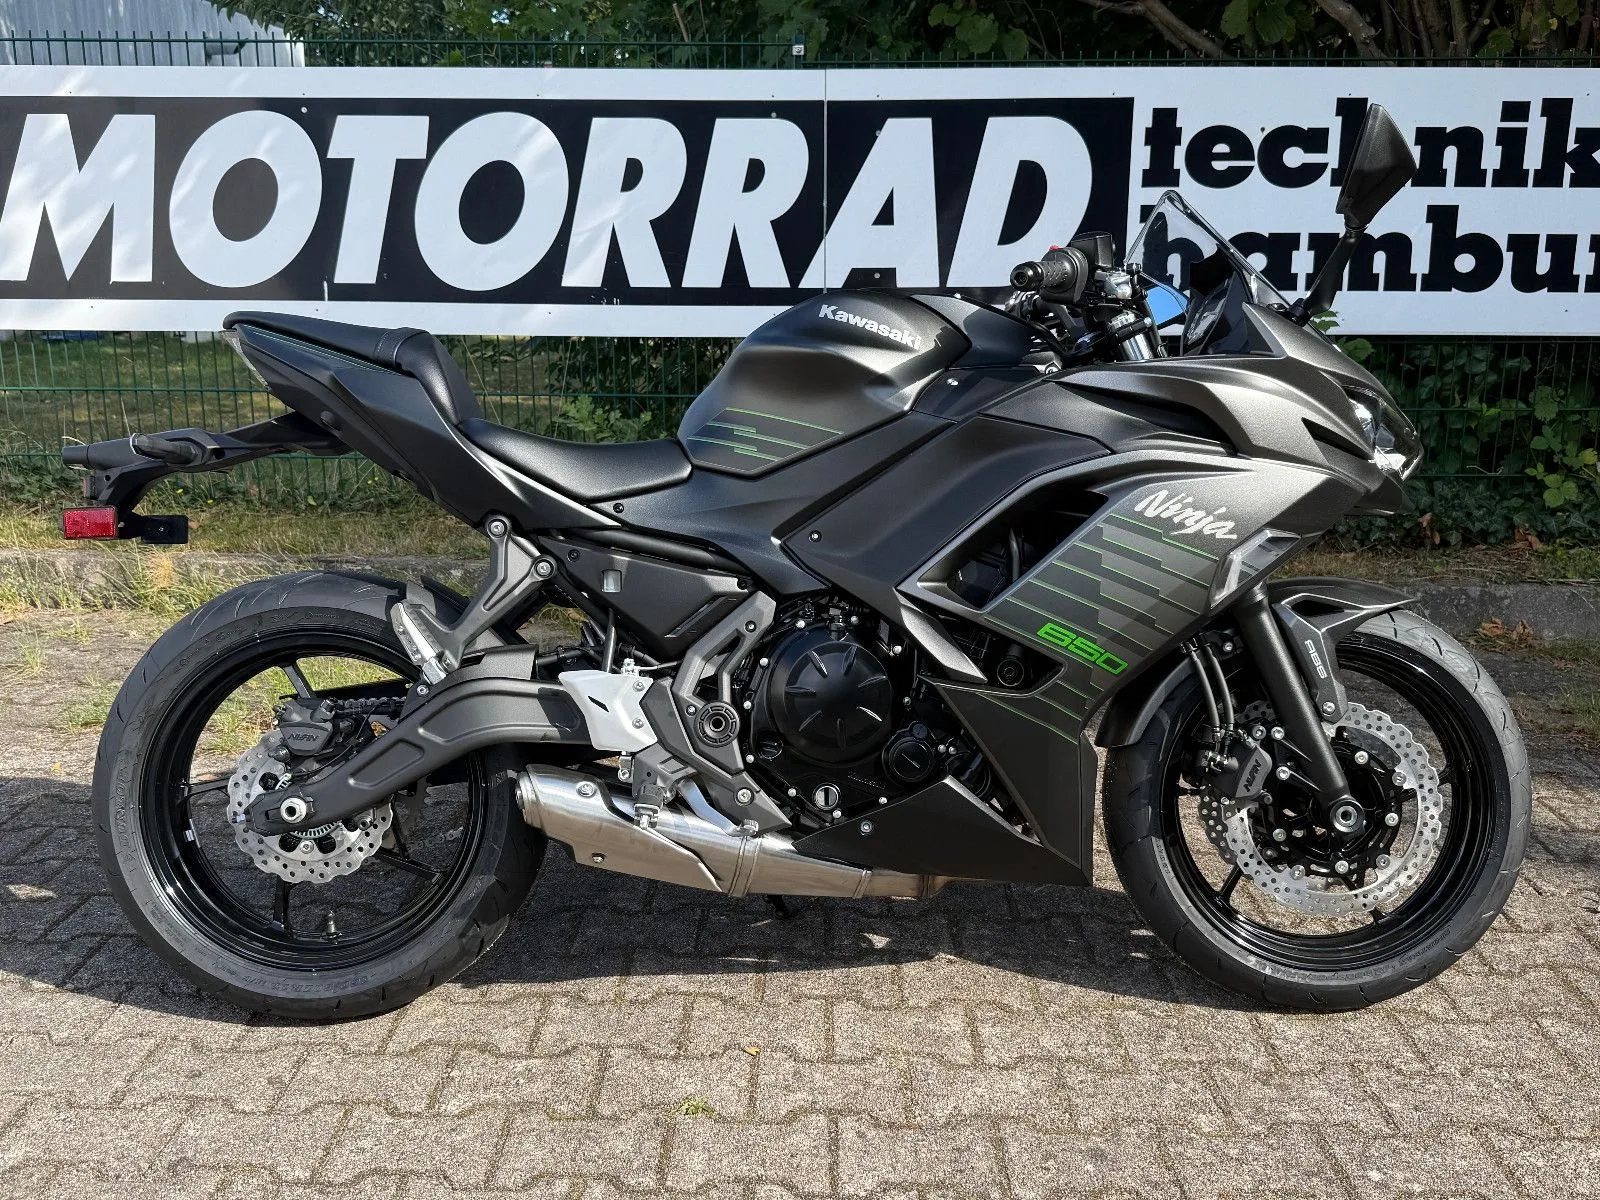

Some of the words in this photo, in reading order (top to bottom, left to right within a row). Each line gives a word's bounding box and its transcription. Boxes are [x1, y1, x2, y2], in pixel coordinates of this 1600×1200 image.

[0, 110, 1093, 292] MOTORRAD
[1139, 204, 1600, 293] hambu
[818, 304, 922, 351] Kawasaki
[1134, 489, 1238, 540] Ninja
[1036, 622, 1129, 675] 650
[1304, 639, 1328, 679] ABS
